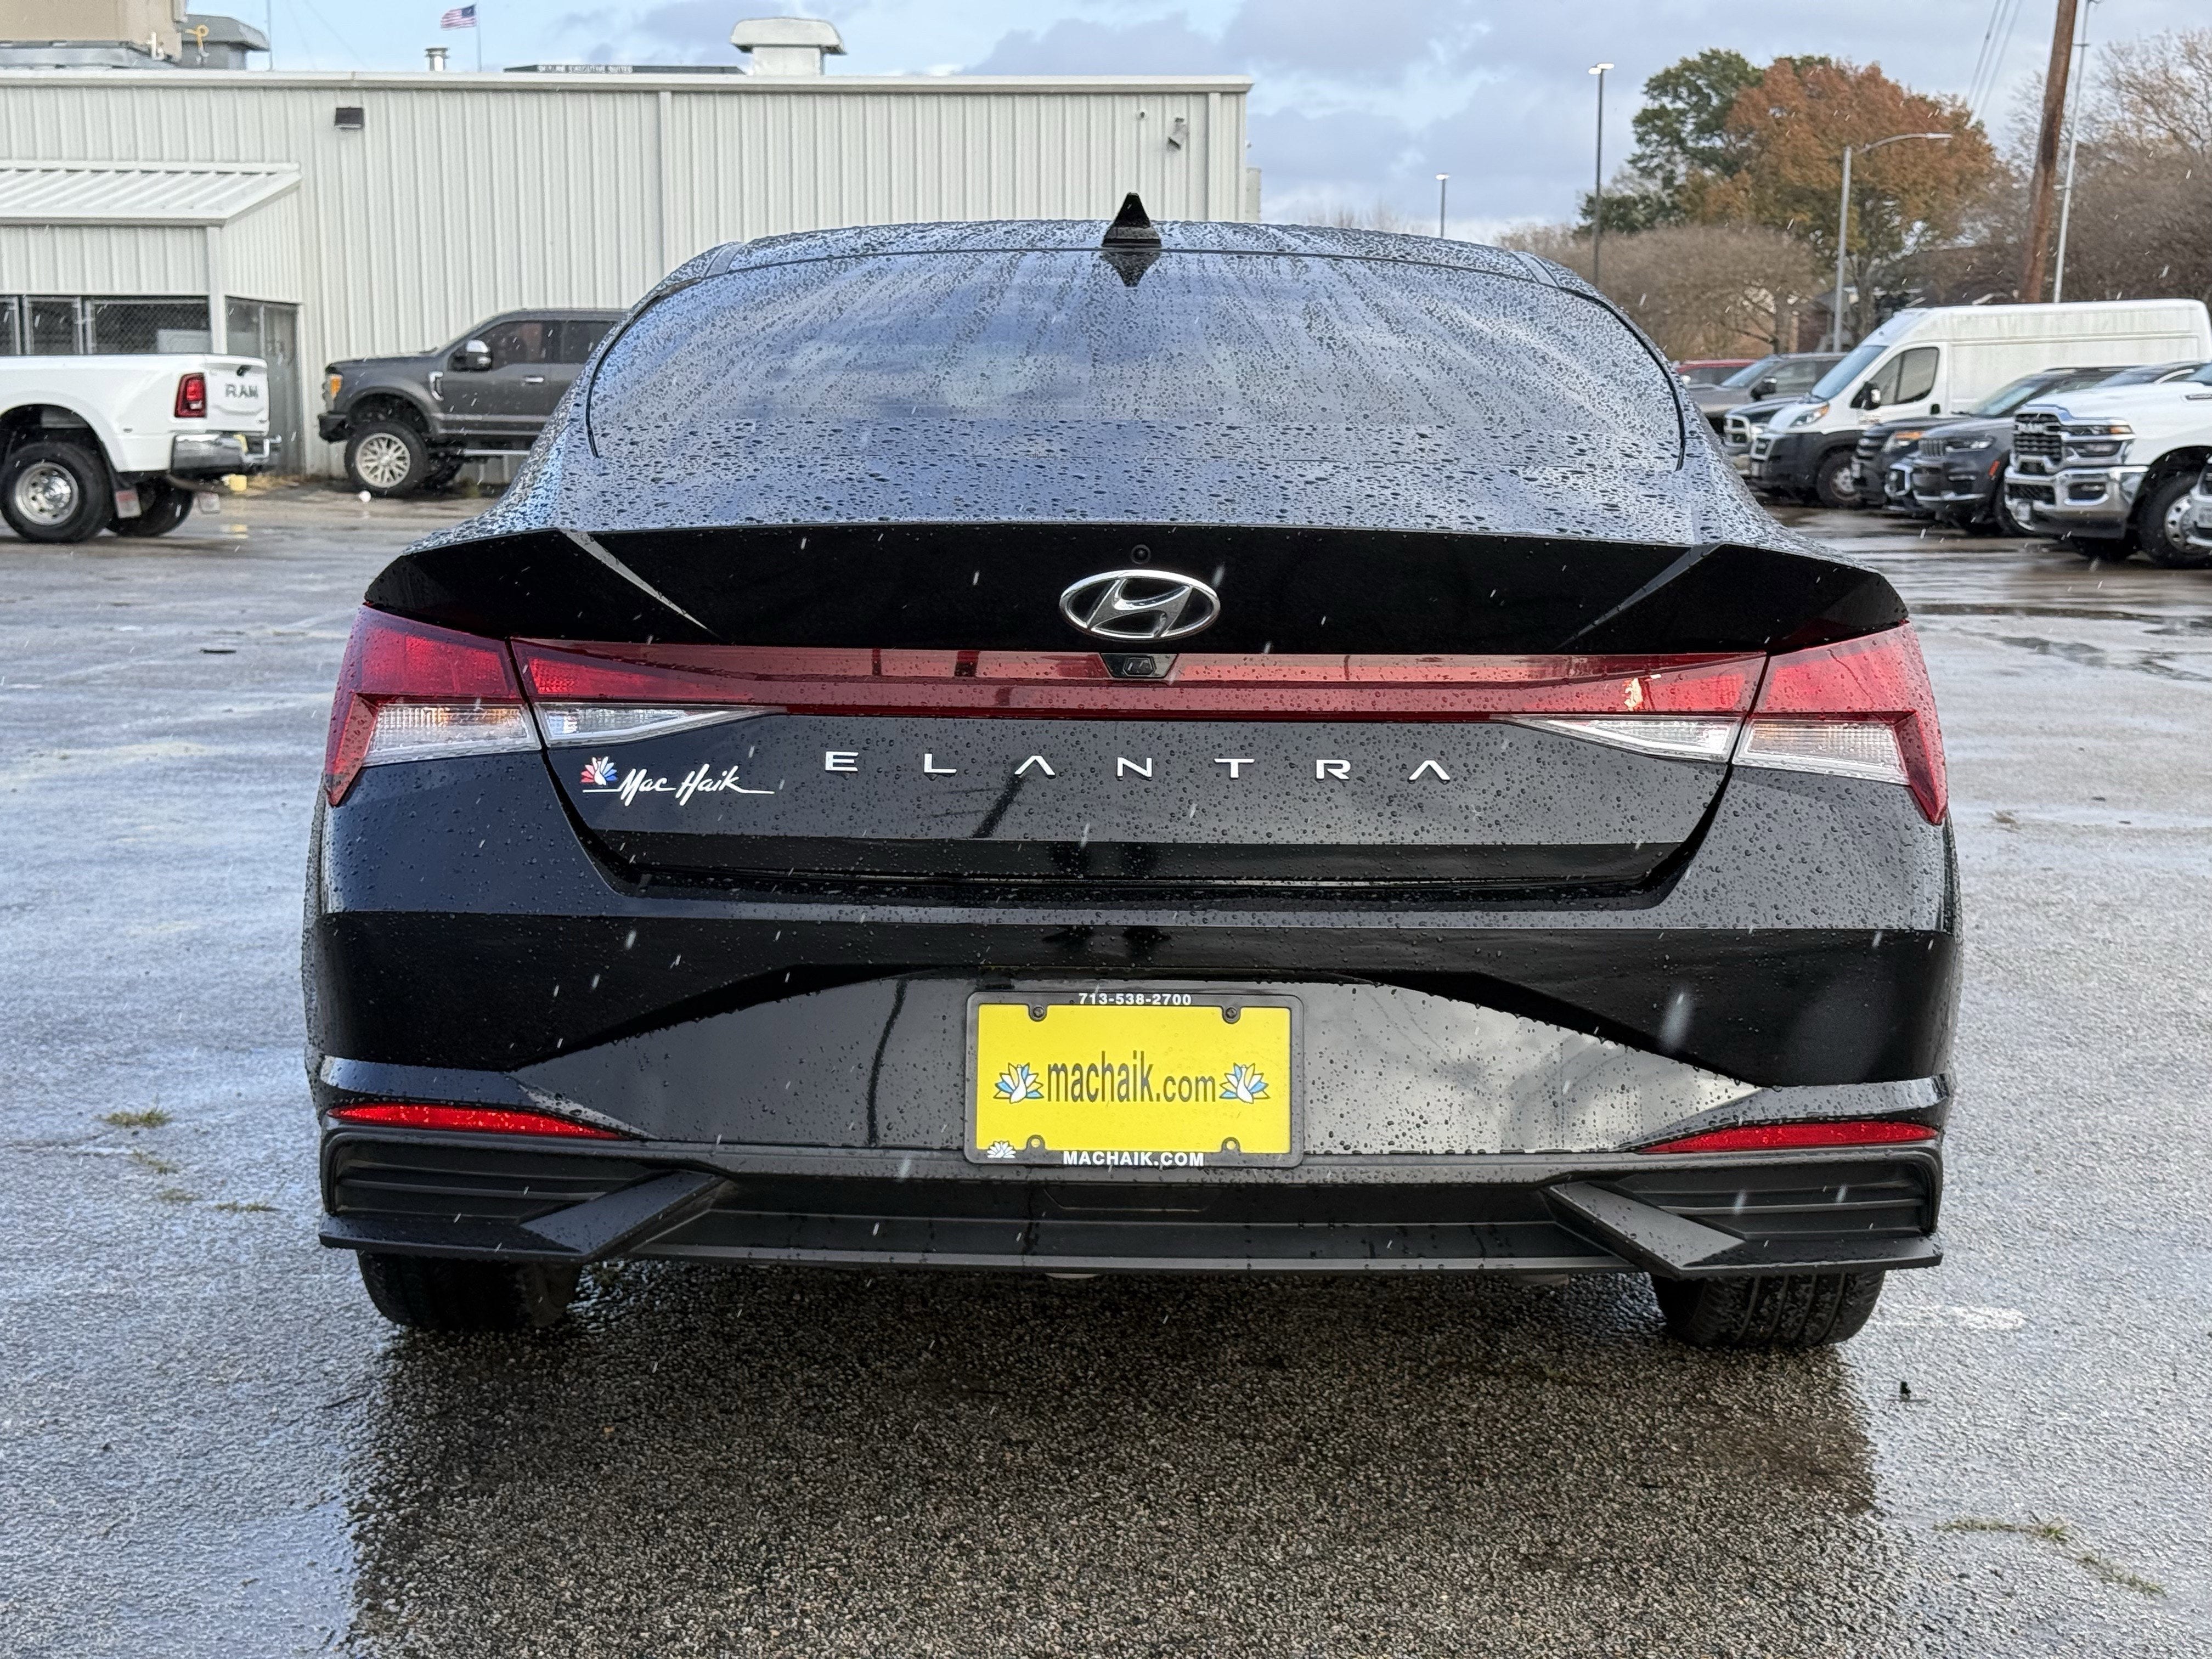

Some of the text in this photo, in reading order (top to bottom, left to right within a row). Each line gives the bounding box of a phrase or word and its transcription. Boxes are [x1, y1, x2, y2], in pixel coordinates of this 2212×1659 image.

[225, 383, 258, 398] RAM
[825, 751, 1451, 781] ELANTRA
[618, 763, 753, 806] Mac Haik
[1077, 992, 1192, 1006] 713-538-2700
[1047, 1050, 1216, 1103] machaik.com
[1063, 1150, 1205, 1166] MACHAIK.COM
